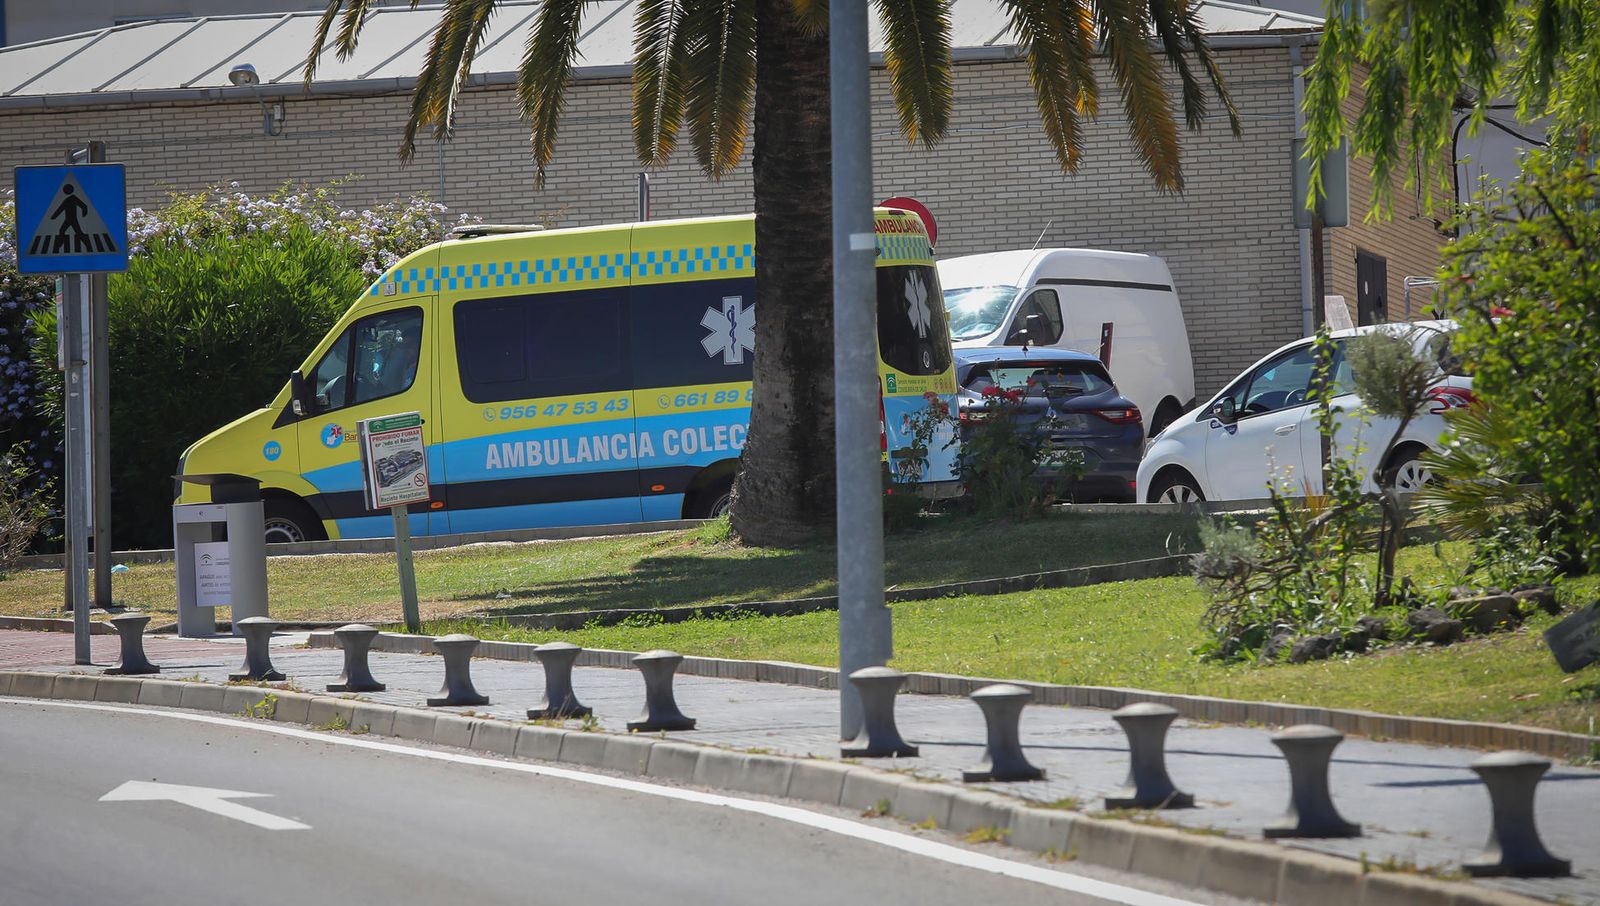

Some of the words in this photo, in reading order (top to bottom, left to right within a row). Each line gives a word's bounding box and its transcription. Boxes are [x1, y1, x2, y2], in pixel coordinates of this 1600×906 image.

[673, 392, 708, 407] 661
[713, 389, 739, 405] 89
[499, 405, 537, 420] 956
[542, 403, 567, 417] 47
[572, 400, 598, 416] 53
[603, 398, 629, 412] 43
[372, 433, 400, 442] PROHIBIDO
[485, 431, 655, 470] AMBULANCIA
[662, 423, 750, 454] COLEC
